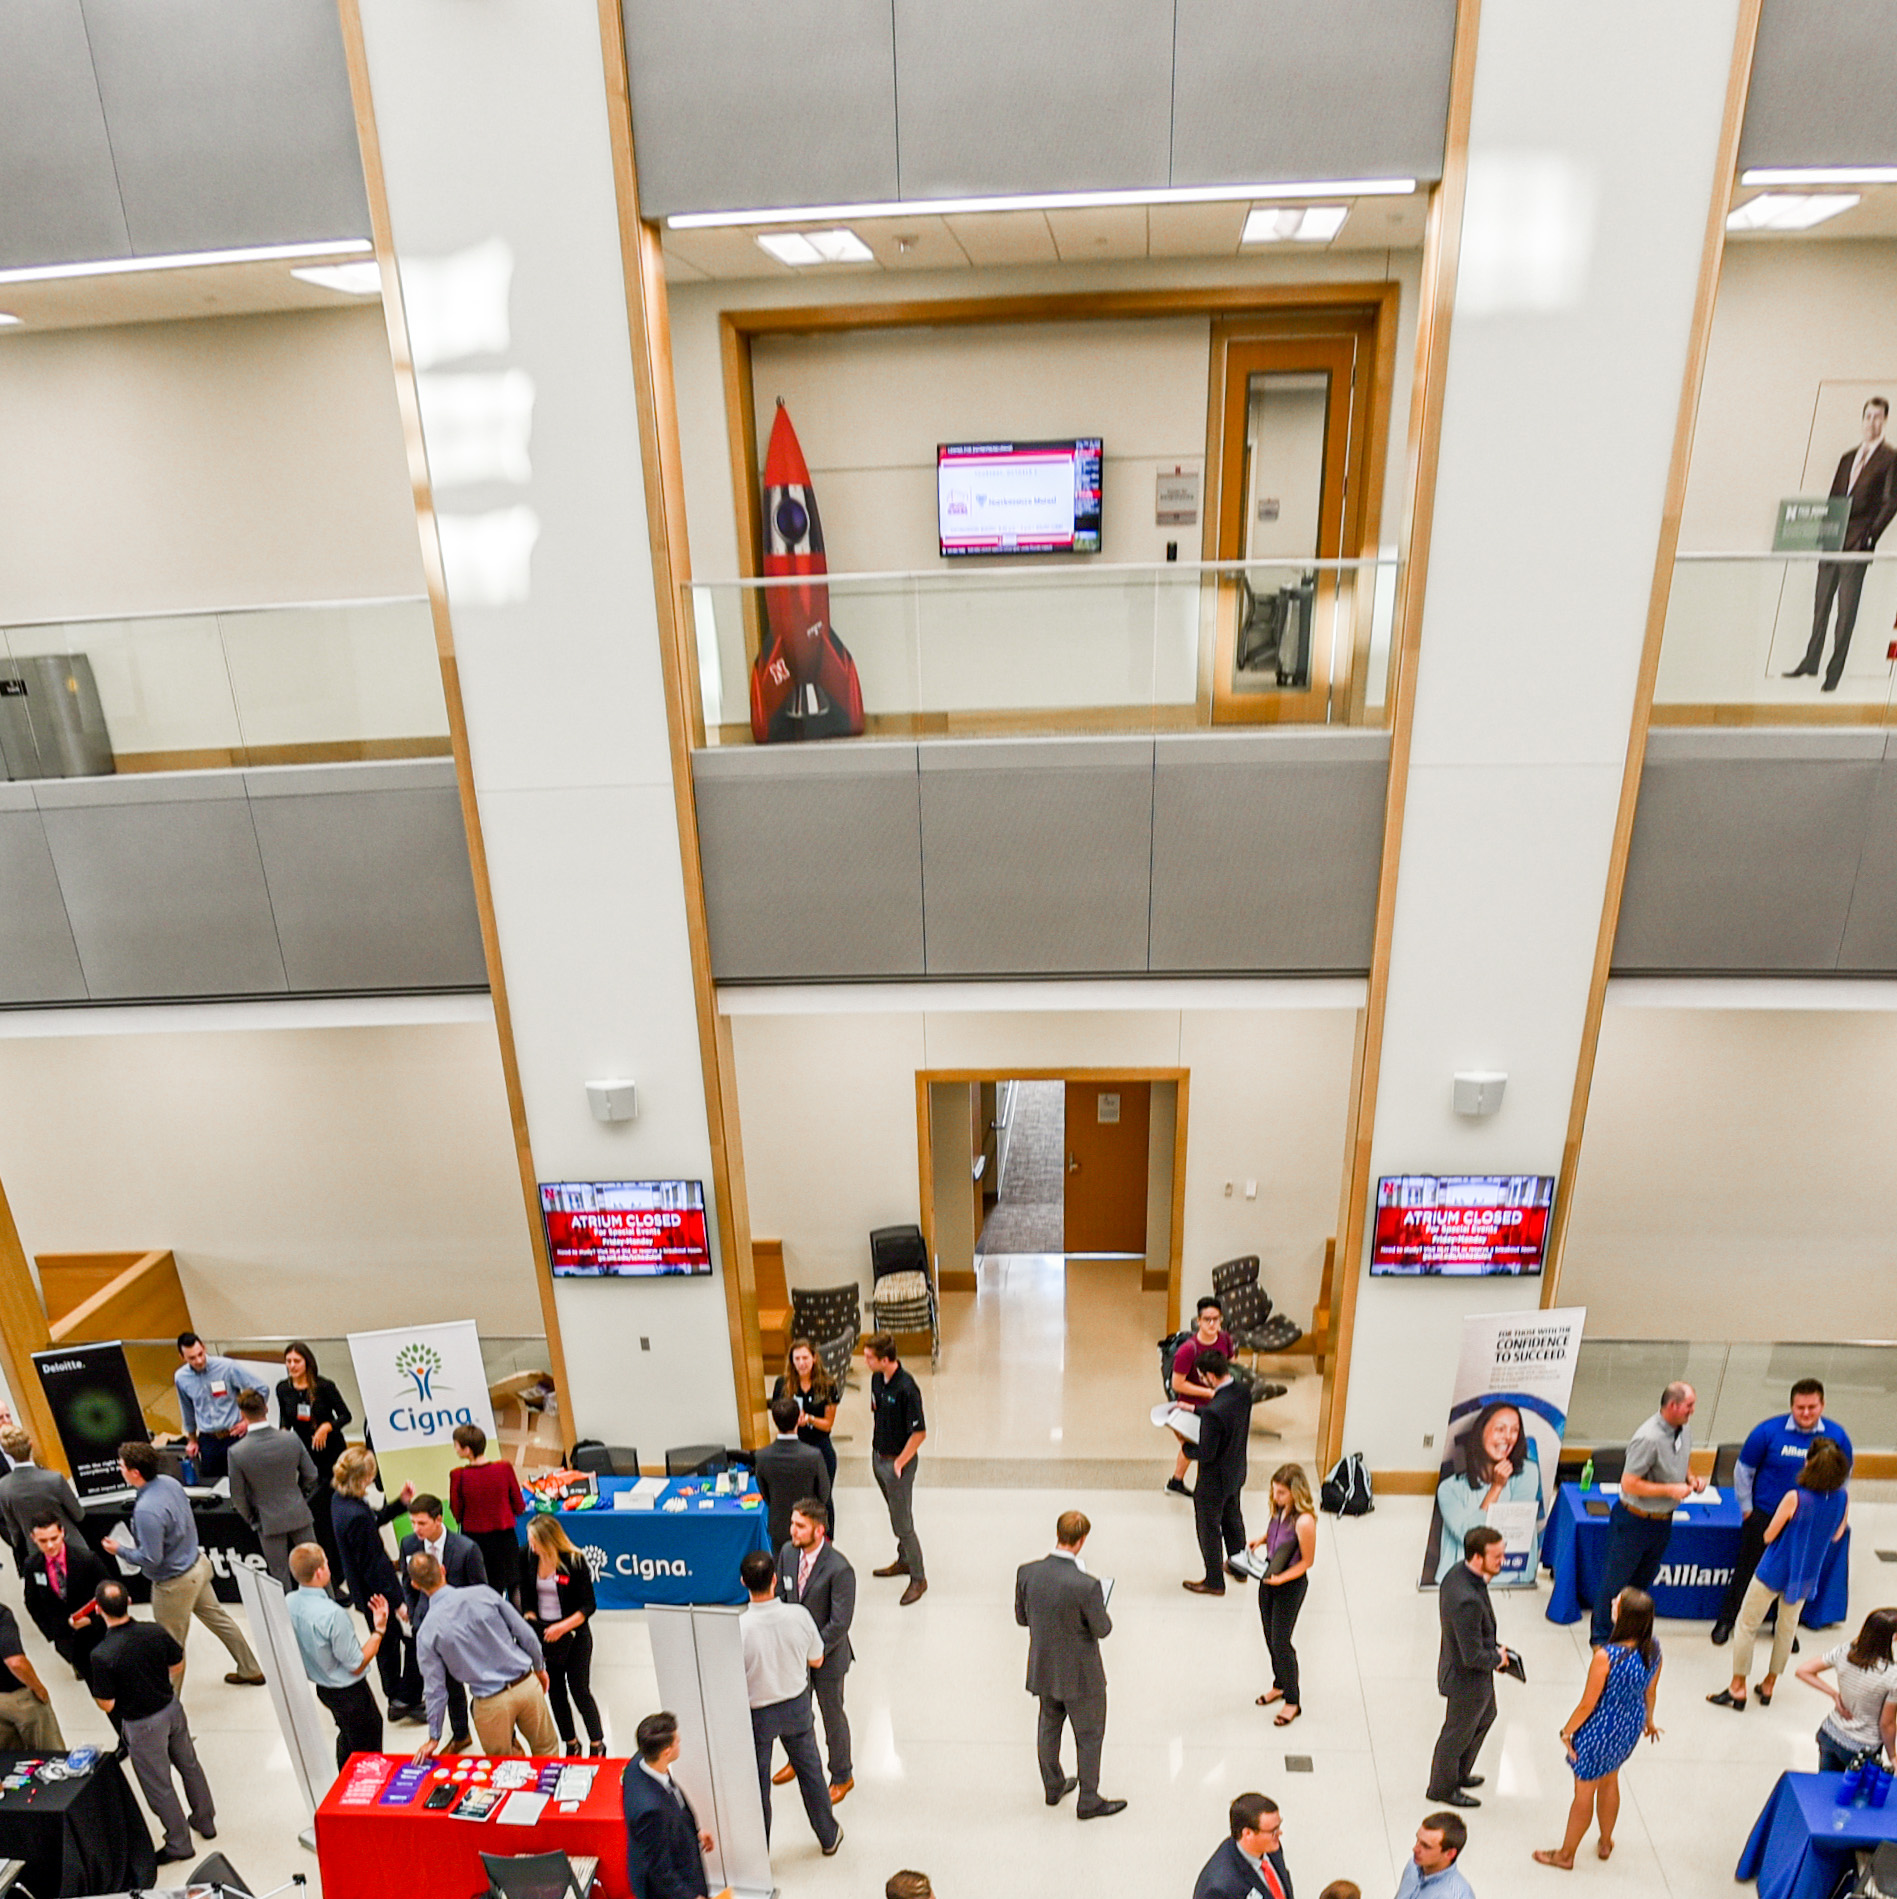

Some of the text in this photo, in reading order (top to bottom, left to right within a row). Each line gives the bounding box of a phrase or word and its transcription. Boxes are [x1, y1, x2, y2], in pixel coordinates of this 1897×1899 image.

[571, 1213, 682, 1229] ATRIUM CLOSED
[1404, 1209, 1523, 1226] ATRIUM CLOSED
[608, 1227, 635, 1237] Special
[636, 1227, 661, 1236] Events
[1441, 1224, 1470, 1235] Special
[1471, 1224, 1499, 1234] Events
[1537, 1327, 1557, 1335] WITH
[1496, 1335, 1569, 1350] CONFIDENCE
[1495, 1348, 1567, 1363] TO SUCCEED.
[1780, 1445, 1808, 1457] Allian
